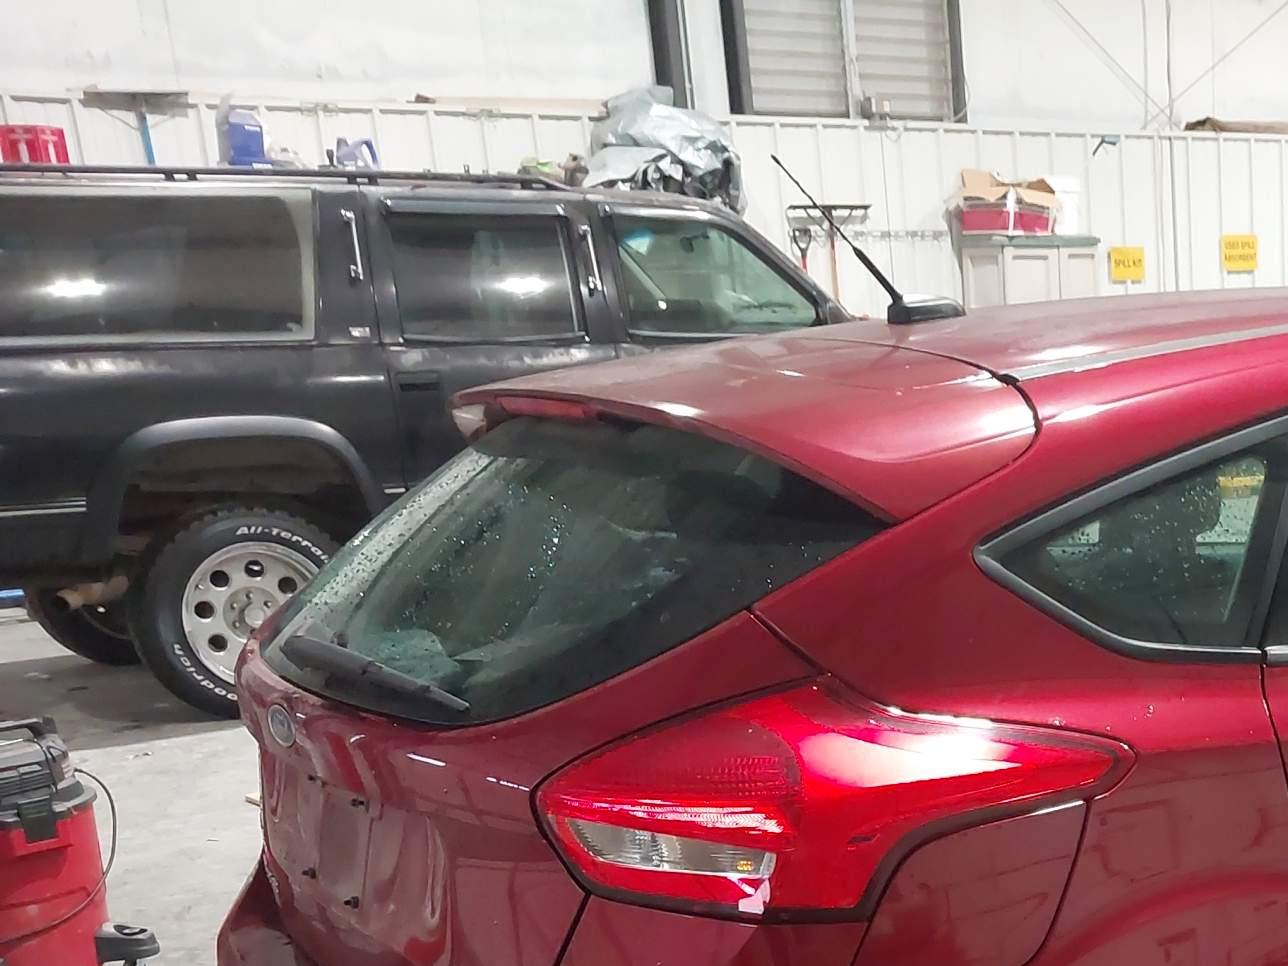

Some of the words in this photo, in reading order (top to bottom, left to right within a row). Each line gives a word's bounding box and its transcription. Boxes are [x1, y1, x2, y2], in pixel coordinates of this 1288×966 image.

[1114, 257, 1131, 268] SPILL
[235, 525, 329, 563] All-Terrai
[172, 643, 239, 701] oodrich
